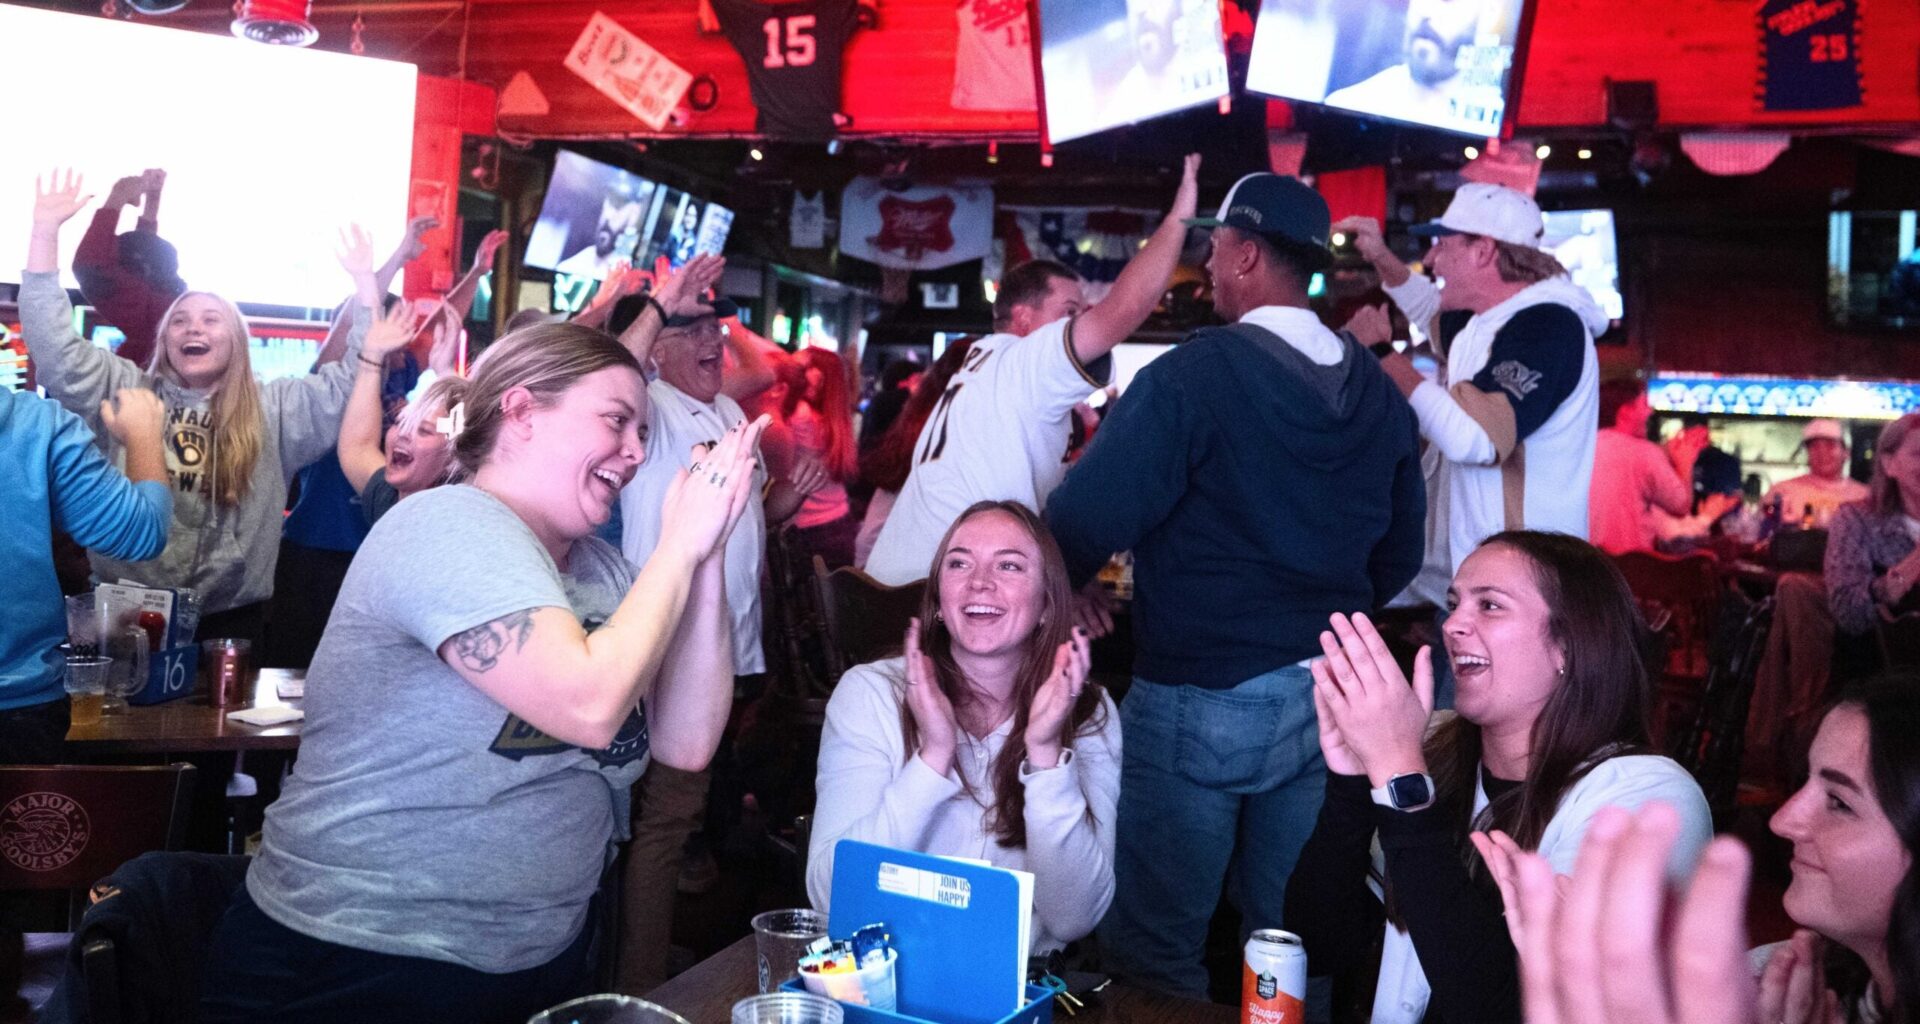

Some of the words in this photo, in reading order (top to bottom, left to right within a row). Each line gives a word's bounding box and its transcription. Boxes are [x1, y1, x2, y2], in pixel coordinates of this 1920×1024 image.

[763, 14, 816, 69] 15
[1809, 34, 1847, 62] 25
[162, 653, 185, 694] 16
[9, 794, 75, 816] MAJOR
[1, 831, 87, 869] GOOLSBY'S
[941, 875, 957, 890] JOIN
[960, 879, 970, 893] US
[938, 890, 965, 907] HAPPY
[1258, 985, 1275, 995] SPACE
[1259, 979, 1276, 988] THIRD
[1248, 1001, 1285, 1023] Happy
